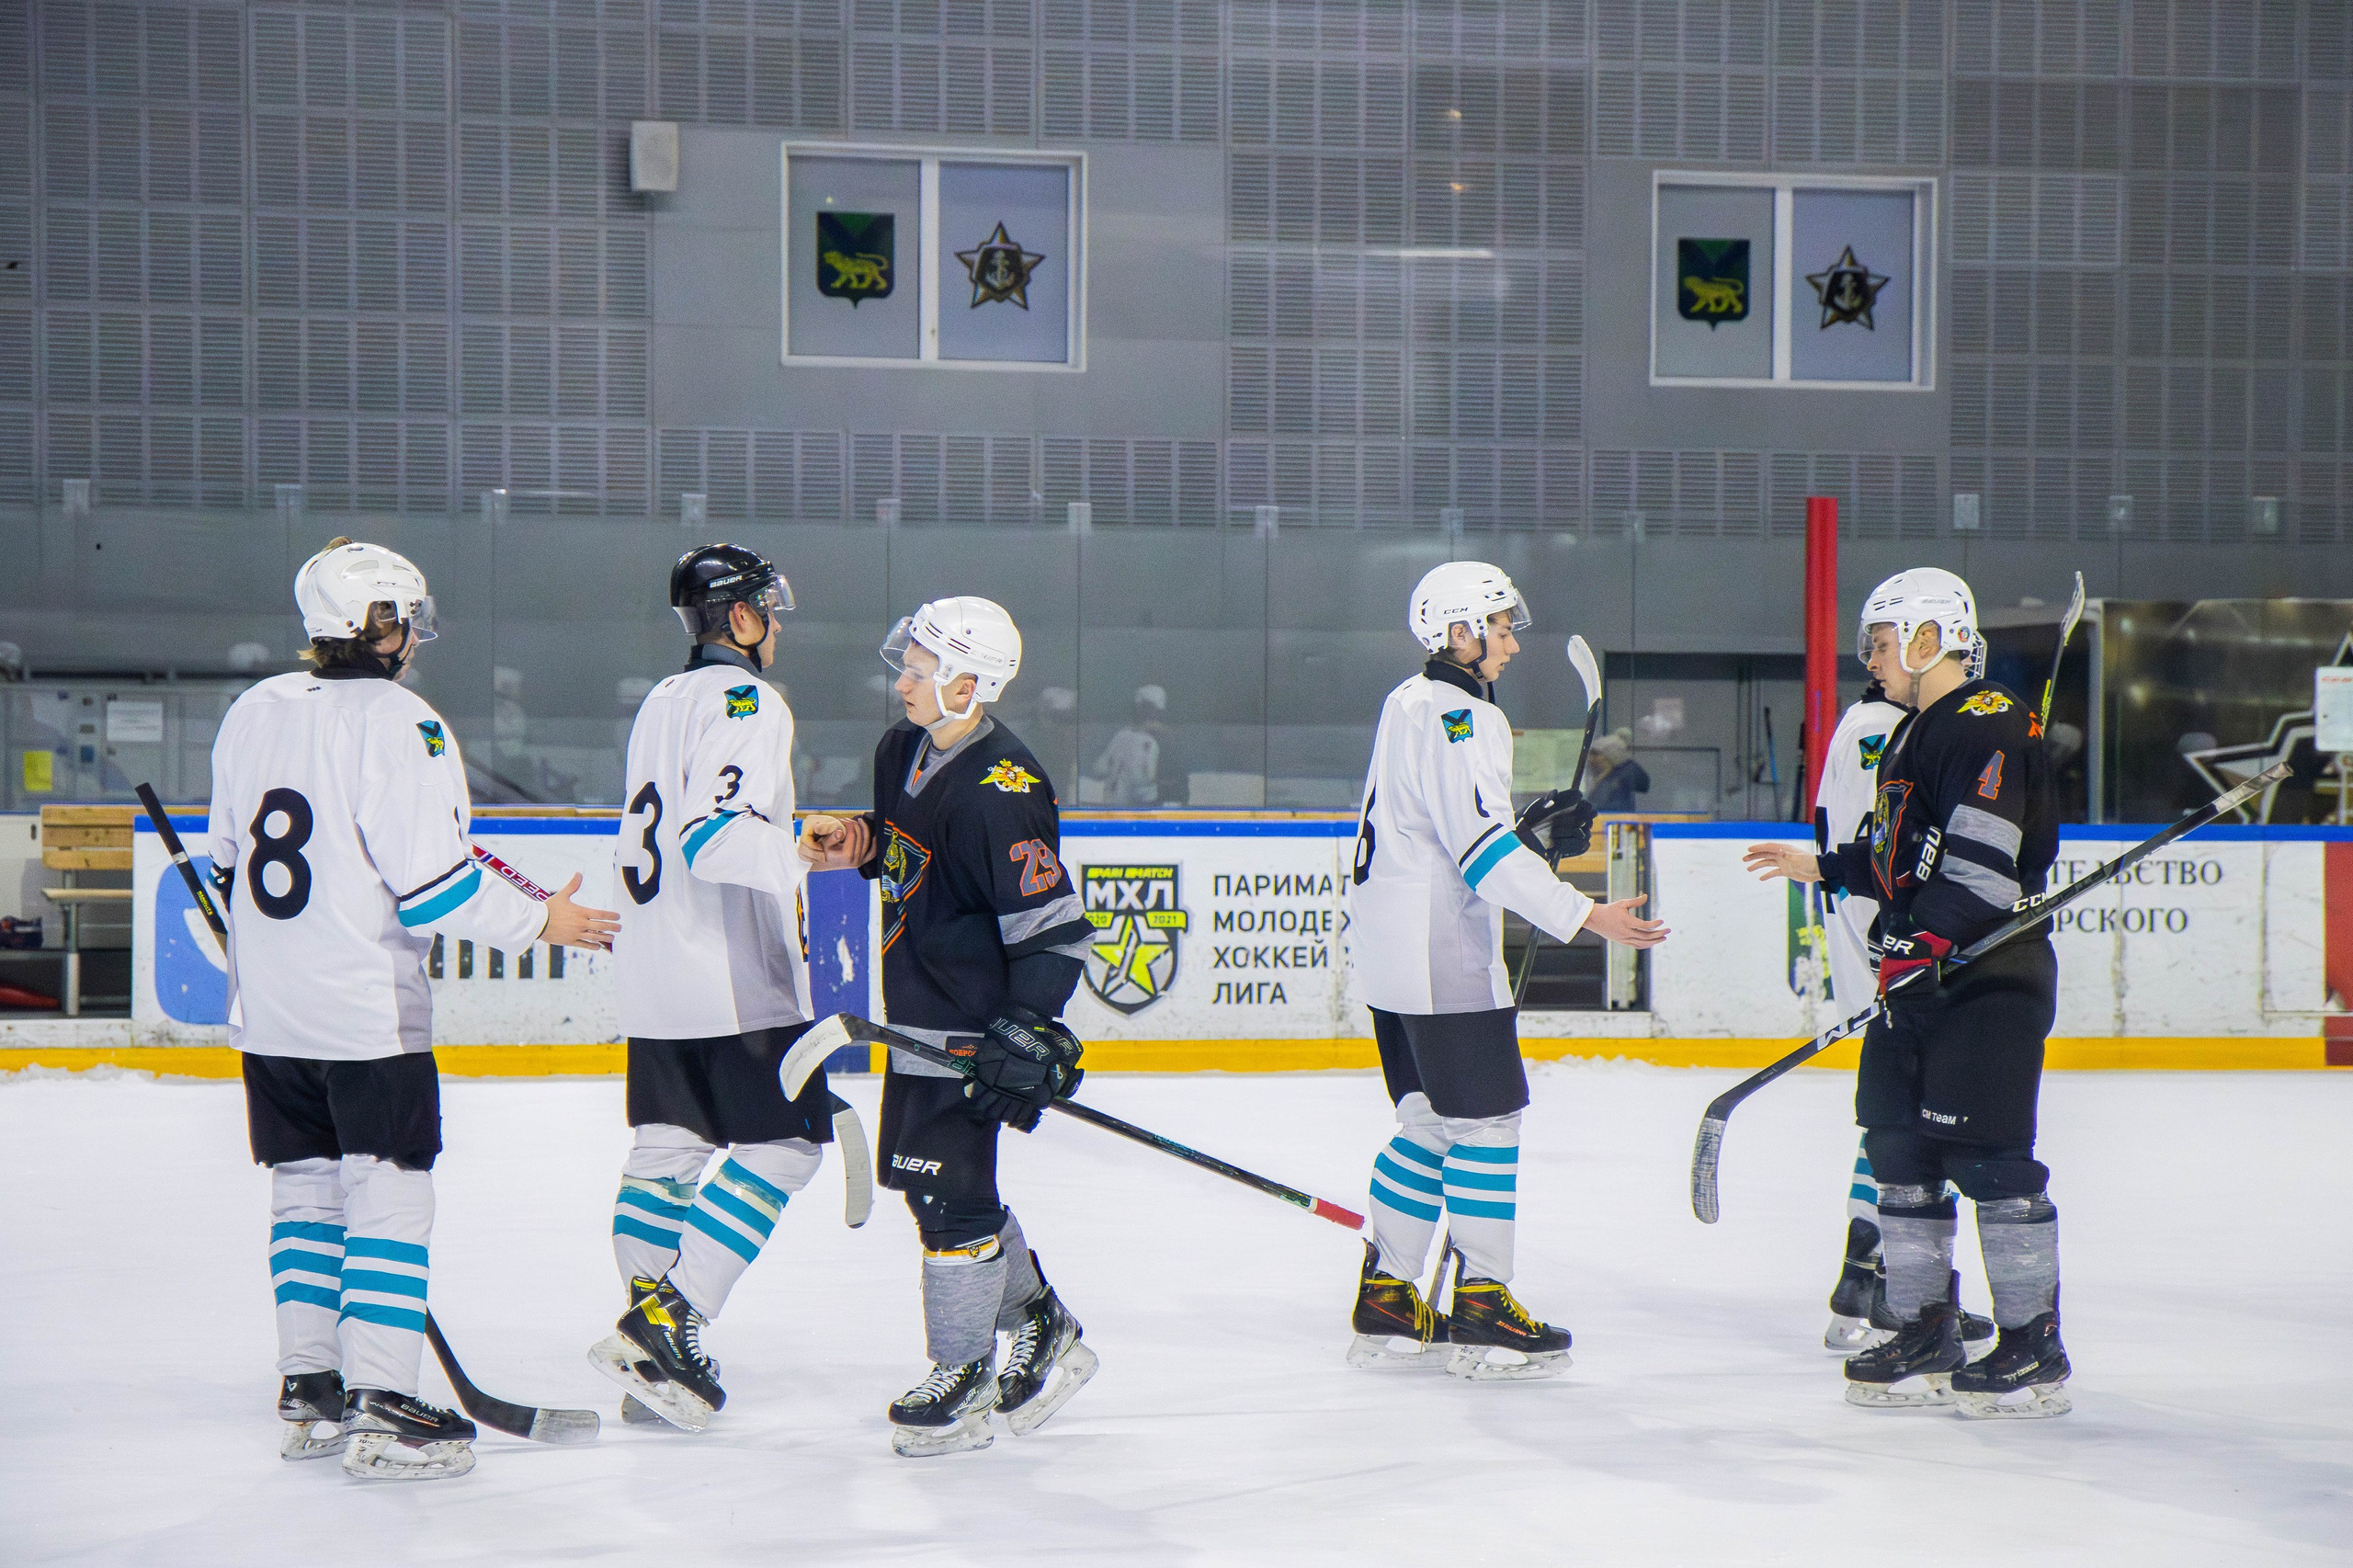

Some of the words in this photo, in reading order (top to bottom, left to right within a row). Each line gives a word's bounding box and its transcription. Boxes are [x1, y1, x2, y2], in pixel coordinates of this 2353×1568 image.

[1443, 607, 1469, 615] CCM
[714, 765, 744, 804] 3
[1977, 750, 2006, 801] 4
[247, 788, 314, 921] 8
[621, 781, 663, 905] 3
[1009, 838, 1062, 897] 29
[1086, 880, 1174, 911] МХЛ
[1211, 982, 1288, 1005] ЛИГА
